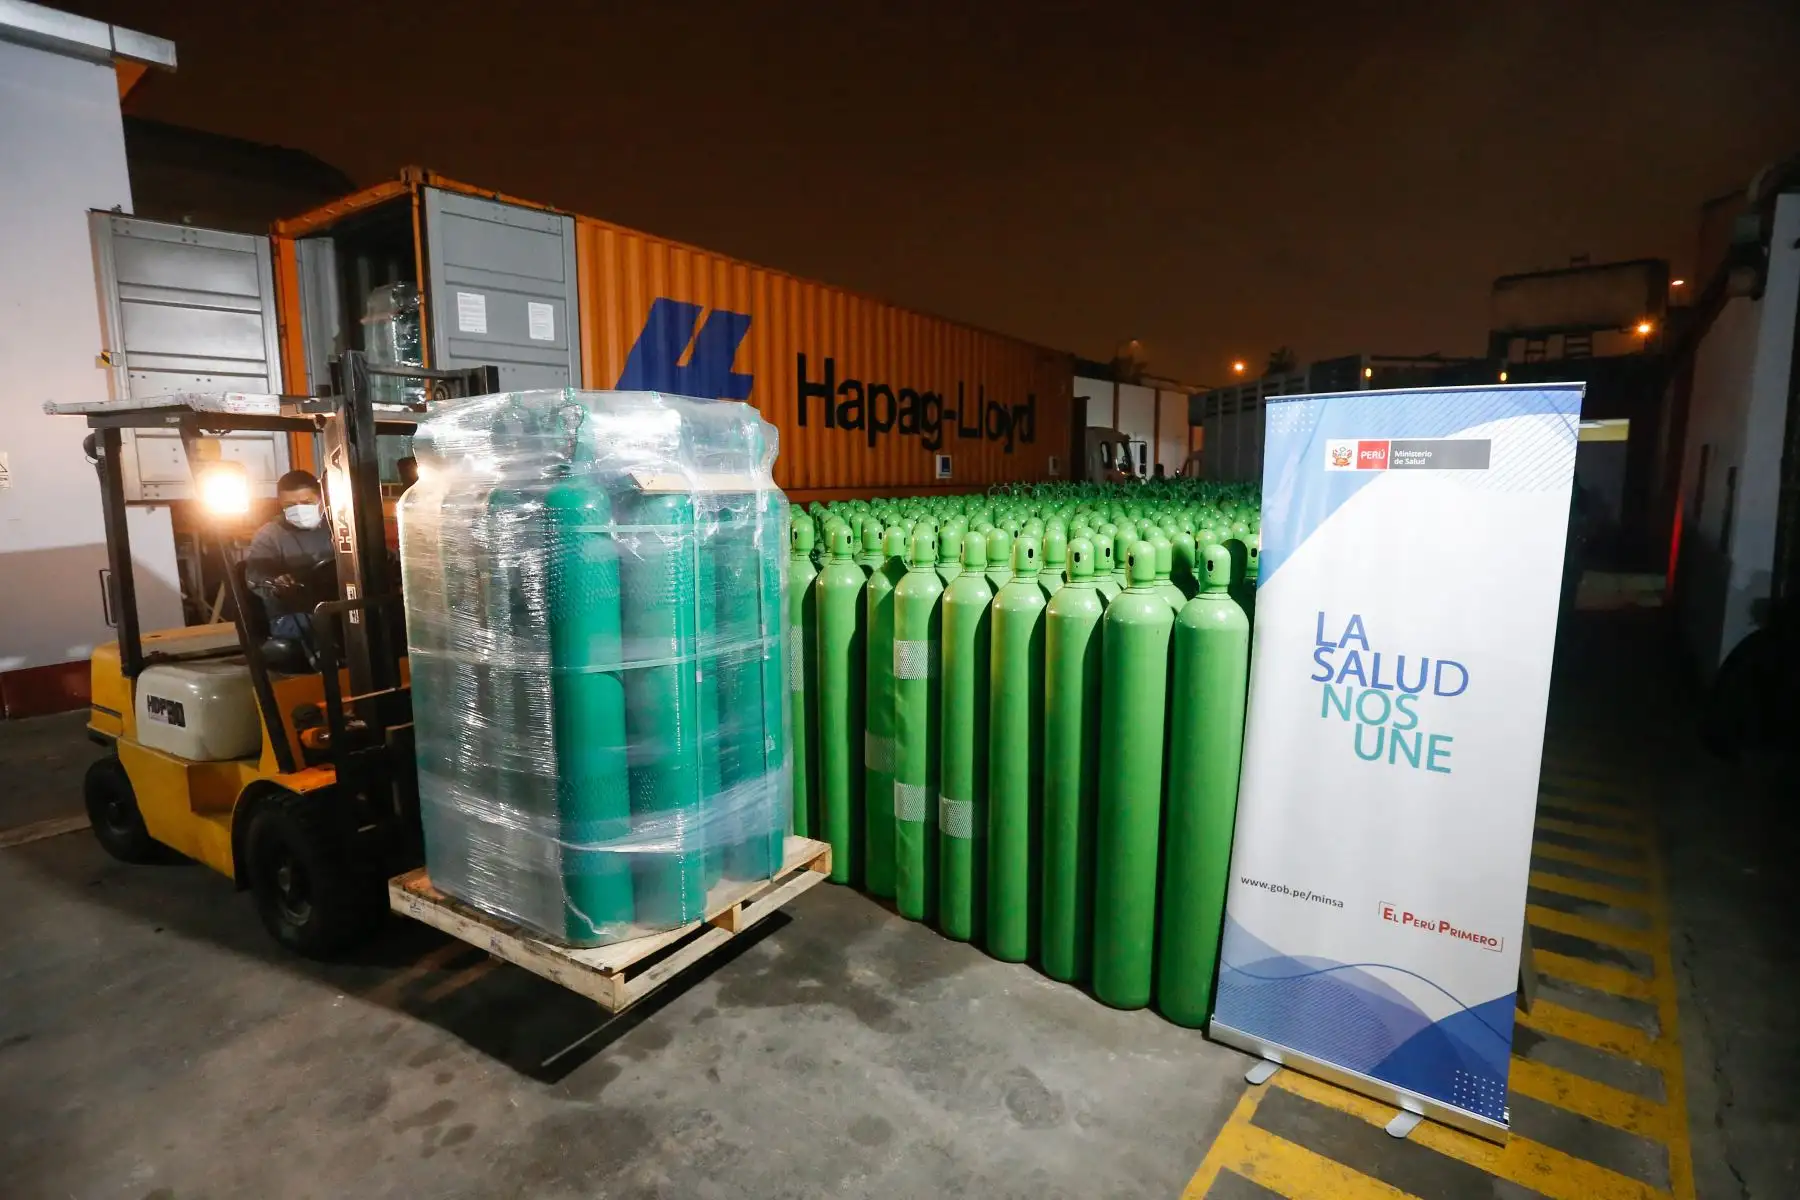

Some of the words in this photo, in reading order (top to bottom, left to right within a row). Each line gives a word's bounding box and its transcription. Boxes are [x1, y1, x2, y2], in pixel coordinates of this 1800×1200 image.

[797, 352, 1036, 454] Hapag-Lloyd
[1360, 448, 1386, 460] PERÚ
[1394, 450, 1432, 459] Ministerio
[1405, 458, 1426, 466] Salud
[1316, 611, 1370, 651] LA
[1311, 647, 1469, 697] SALUD
[1321, 683, 1419, 731] NOS
[1354, 723, 1453, 774] UNE
[1240, 875, 1345, 908] www.gob.pe/minsa
